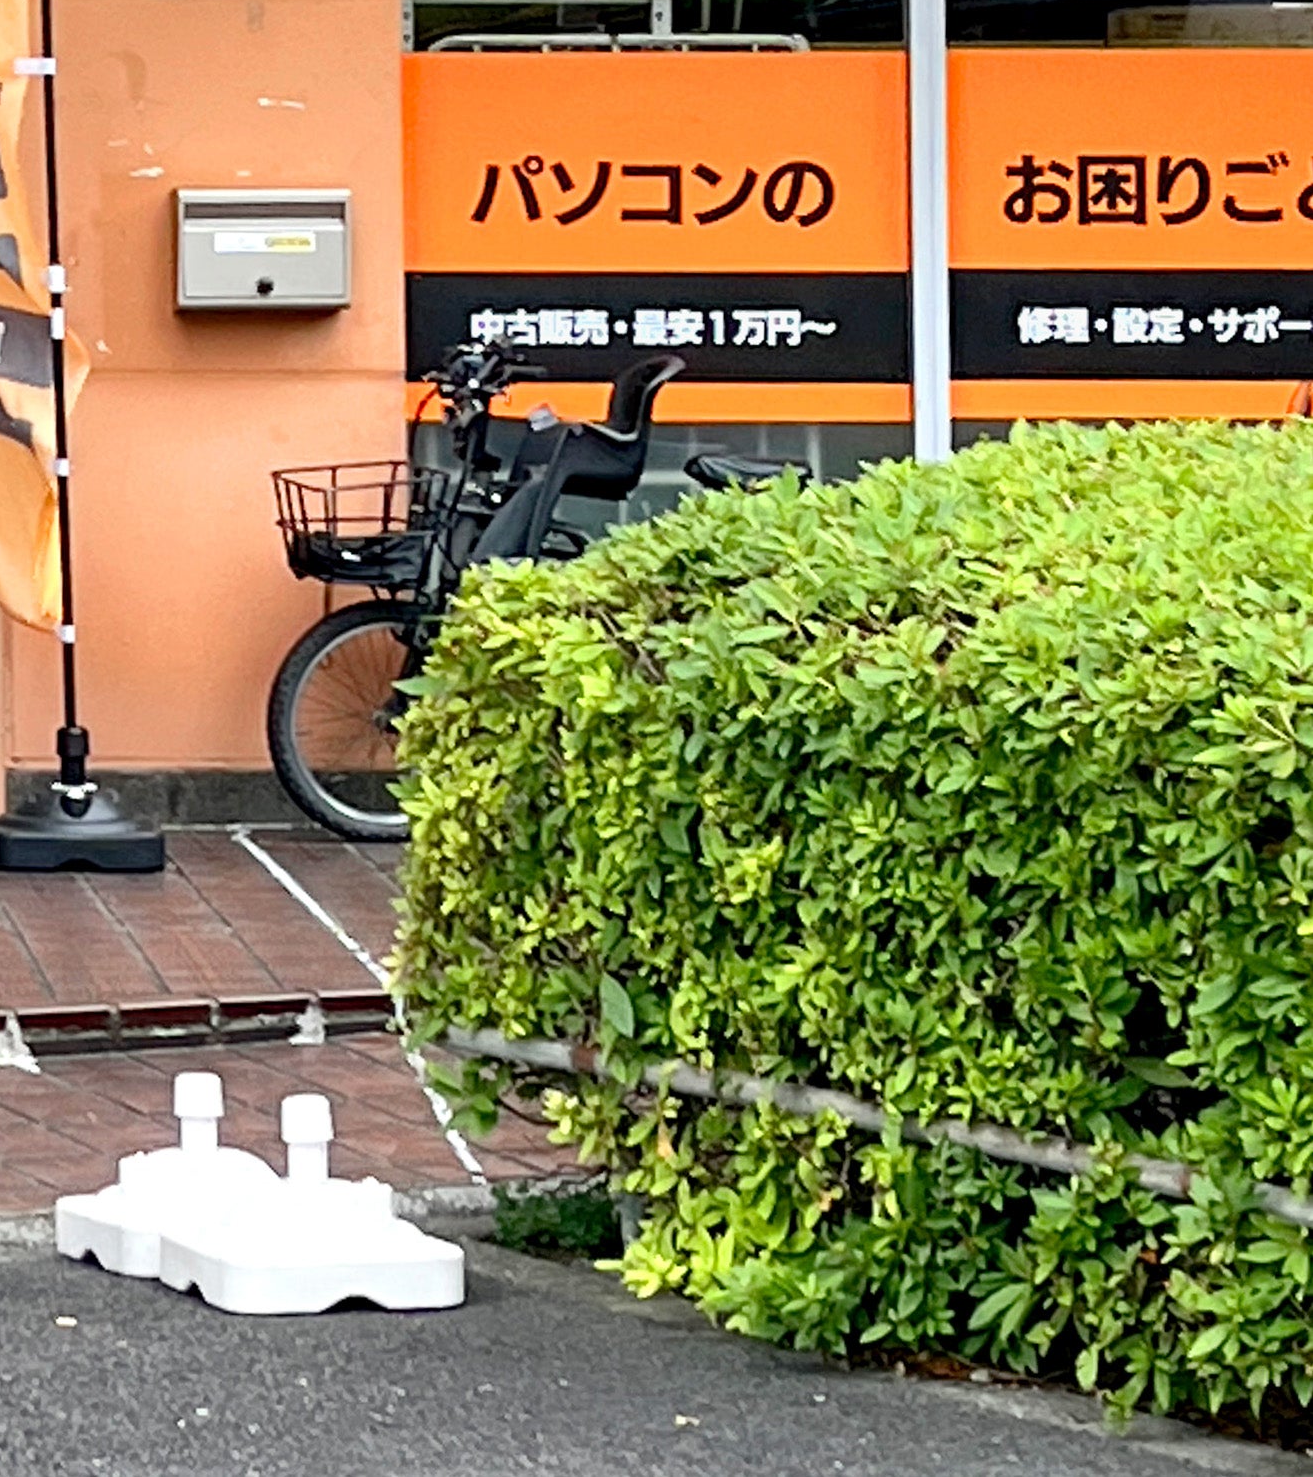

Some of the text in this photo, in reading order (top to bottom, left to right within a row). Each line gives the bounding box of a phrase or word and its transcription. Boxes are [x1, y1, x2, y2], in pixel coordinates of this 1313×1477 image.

[472, 154, 836, 227] パソコンの
[1004, 151, 1313, 226] お困りご
